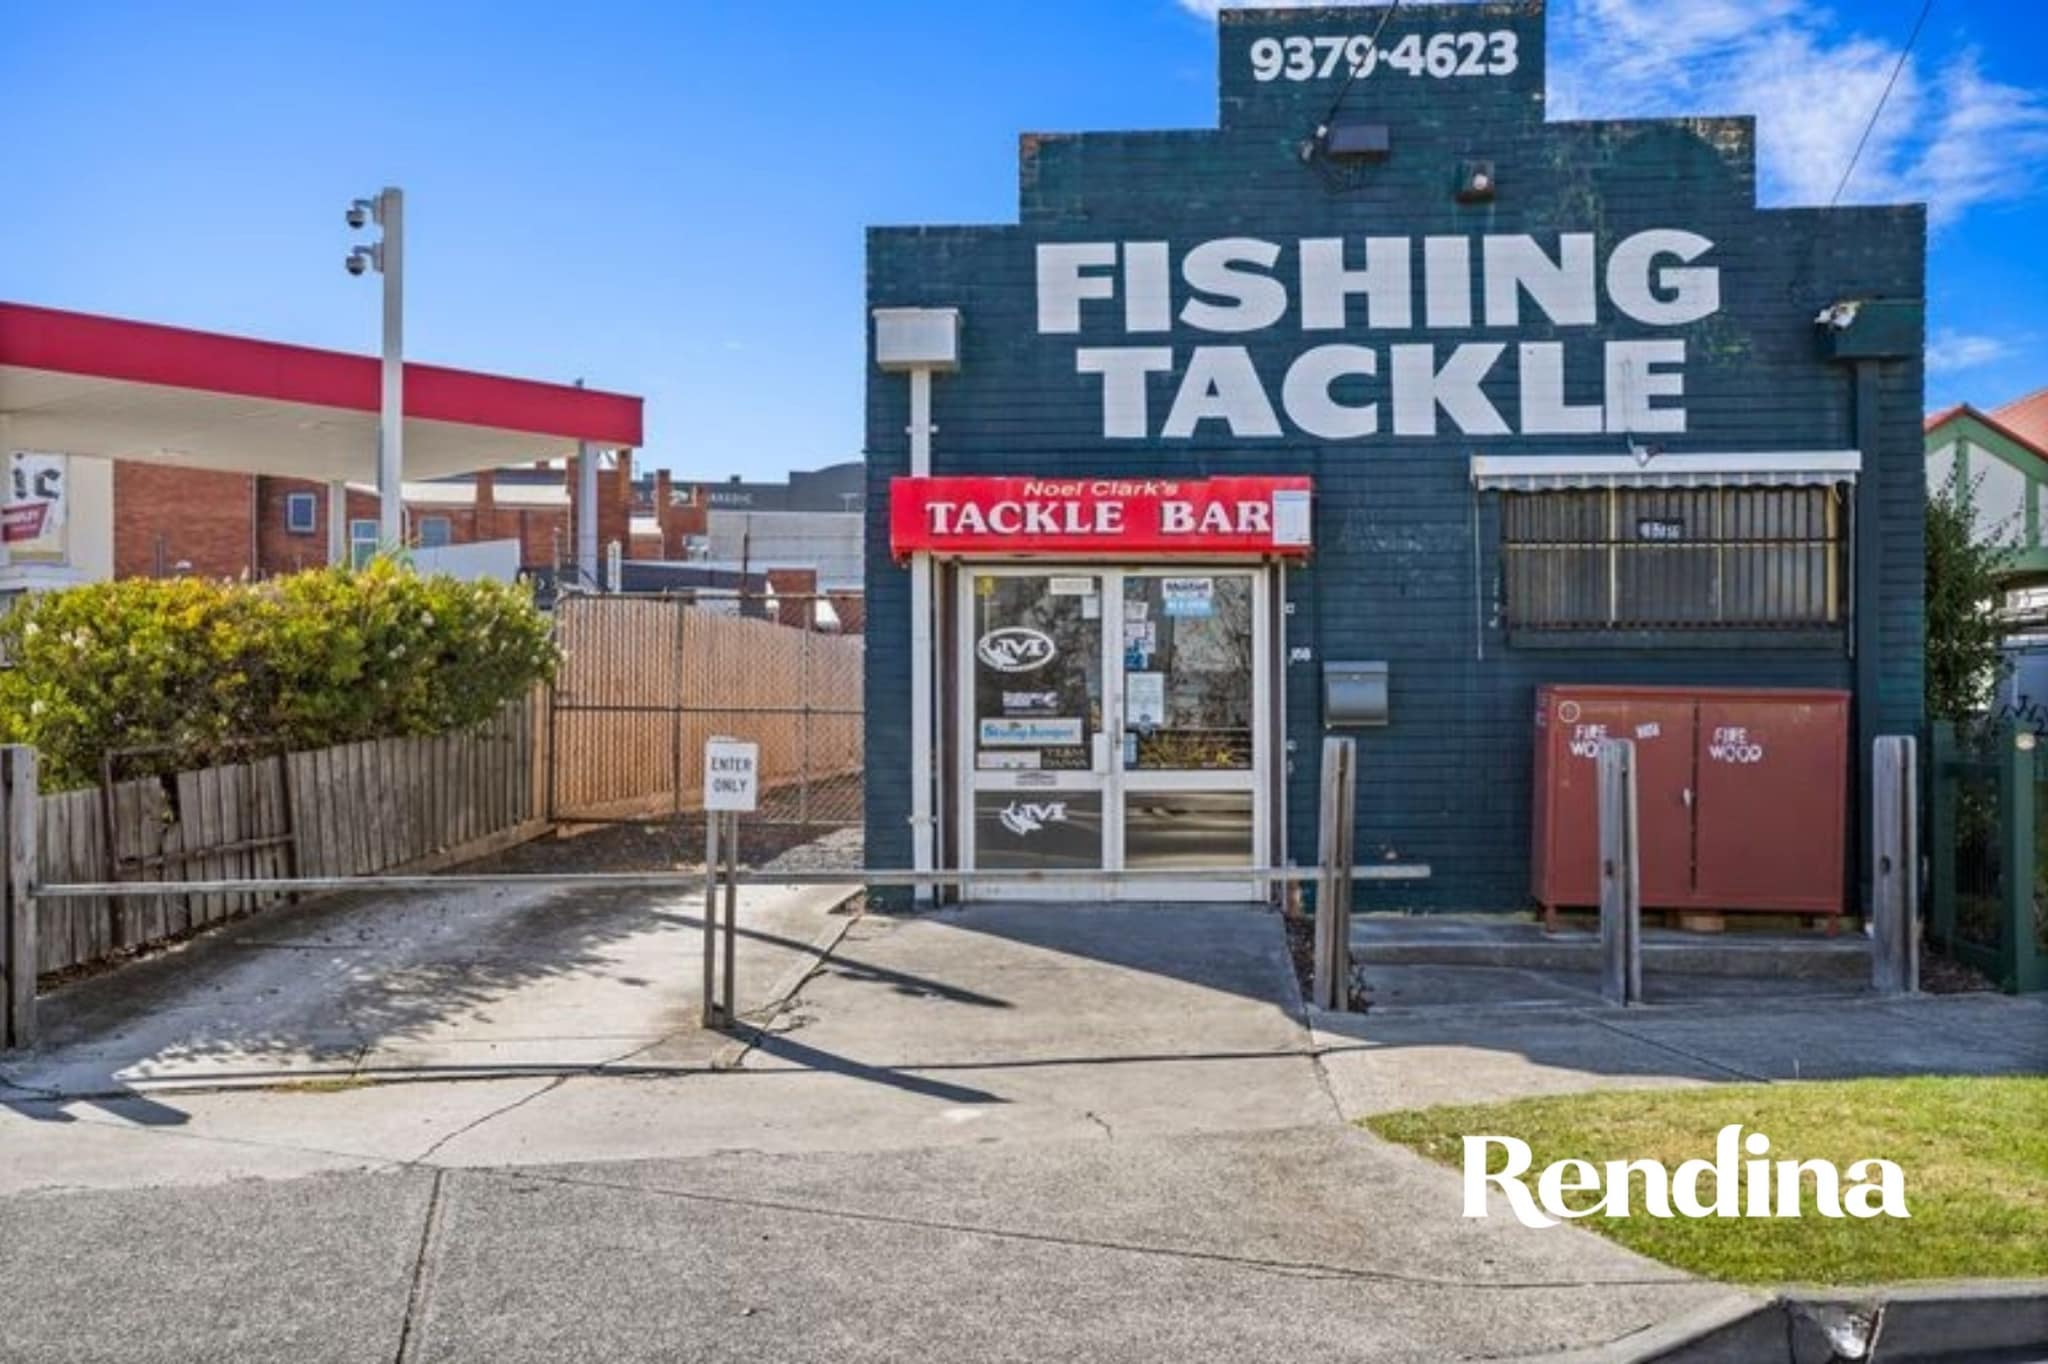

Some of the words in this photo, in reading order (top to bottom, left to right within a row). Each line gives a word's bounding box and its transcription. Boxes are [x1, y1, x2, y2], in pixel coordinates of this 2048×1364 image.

[1036, 229, 1720, 334] FISHING
[1077, 339, 1688, 440] TACKLE
[1023, 481, 1081, 497] Noel
[1090, 481, 1179, 497] Clark's
[925, 500, 1124, 534] TACKLE
[1159, 500, 1272, 534] BAR
[1575, 724, 1608, 739] FIRE
[1713, 727, 1747, 744] FIRE
[1709, 744, 1763, 763] WOOD
[711, 756, 753, 772] ENTER
[712, 777, 747, 793] ONLY
